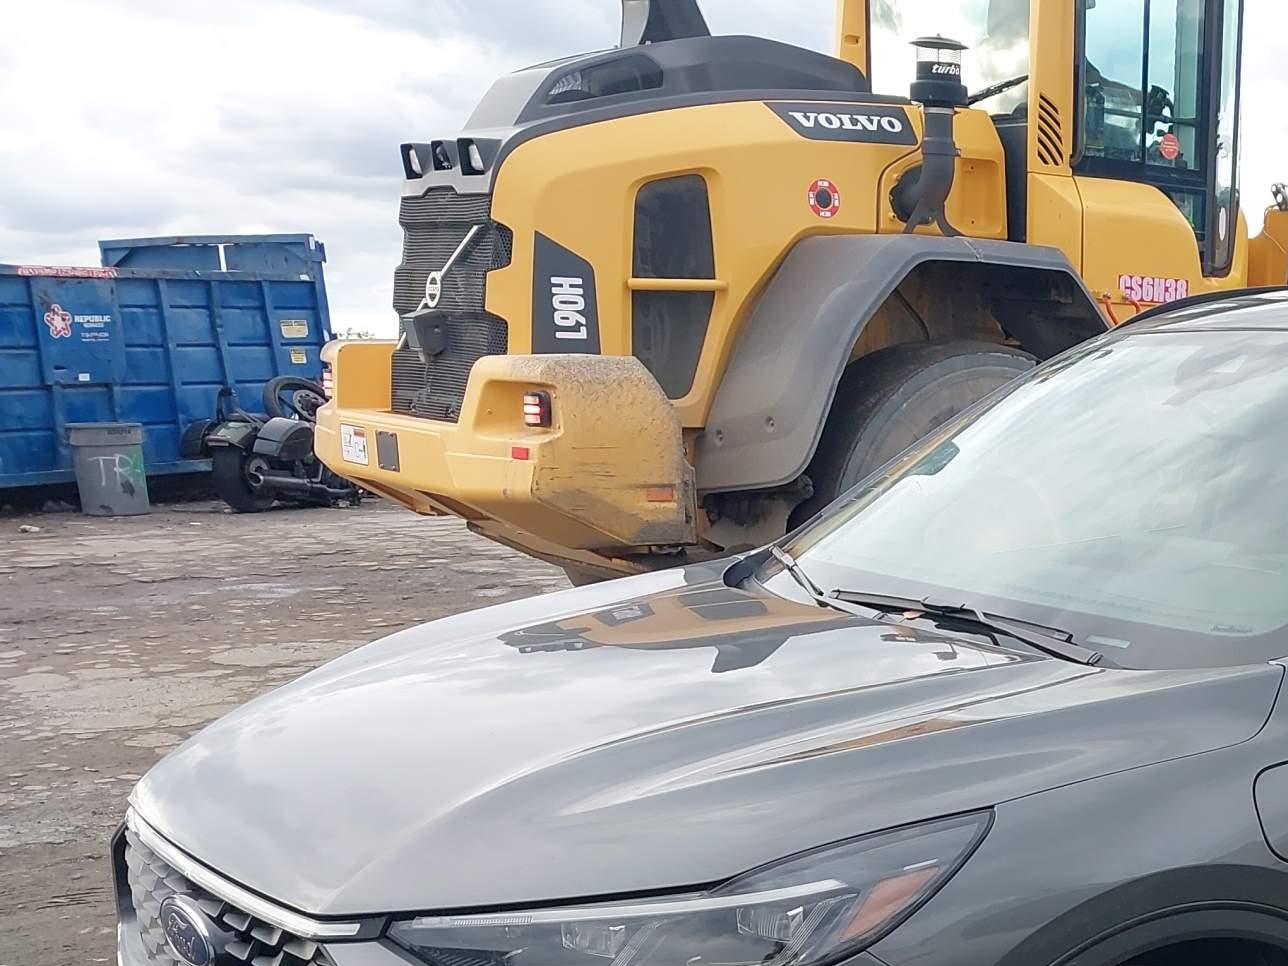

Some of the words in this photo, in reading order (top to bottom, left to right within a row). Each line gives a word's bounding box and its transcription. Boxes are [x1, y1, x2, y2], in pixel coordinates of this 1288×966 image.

[931, 64, 960, 75] turbo
[788, 111, 903, 133] VOLVO
[1119, 274, 1187, 302] CS6H38
[74, 315, 111, 323] REPUBLIC
[550, 276, 588, 339] L90H
[166, 912, 196, 961] Ford
